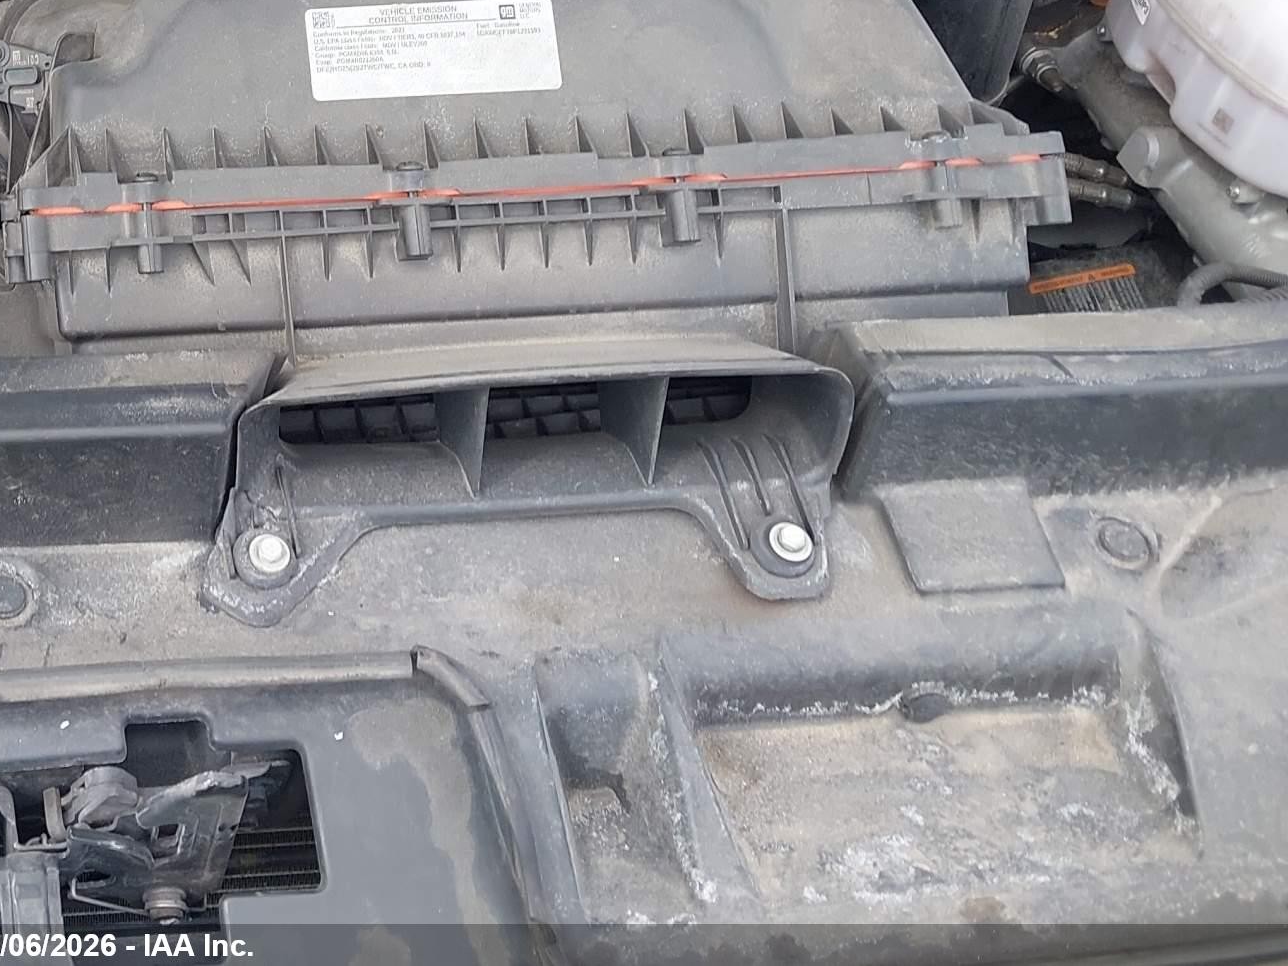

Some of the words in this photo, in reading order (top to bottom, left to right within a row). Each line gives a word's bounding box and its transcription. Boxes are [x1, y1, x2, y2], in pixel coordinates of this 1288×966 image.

[379, 7, 416, 16] VEHICLE
[417, 5, 457, 14] EMISSION
[368, 15, 407, 24] CONTROL
[411, 12, 468, 23] INFORMATION
